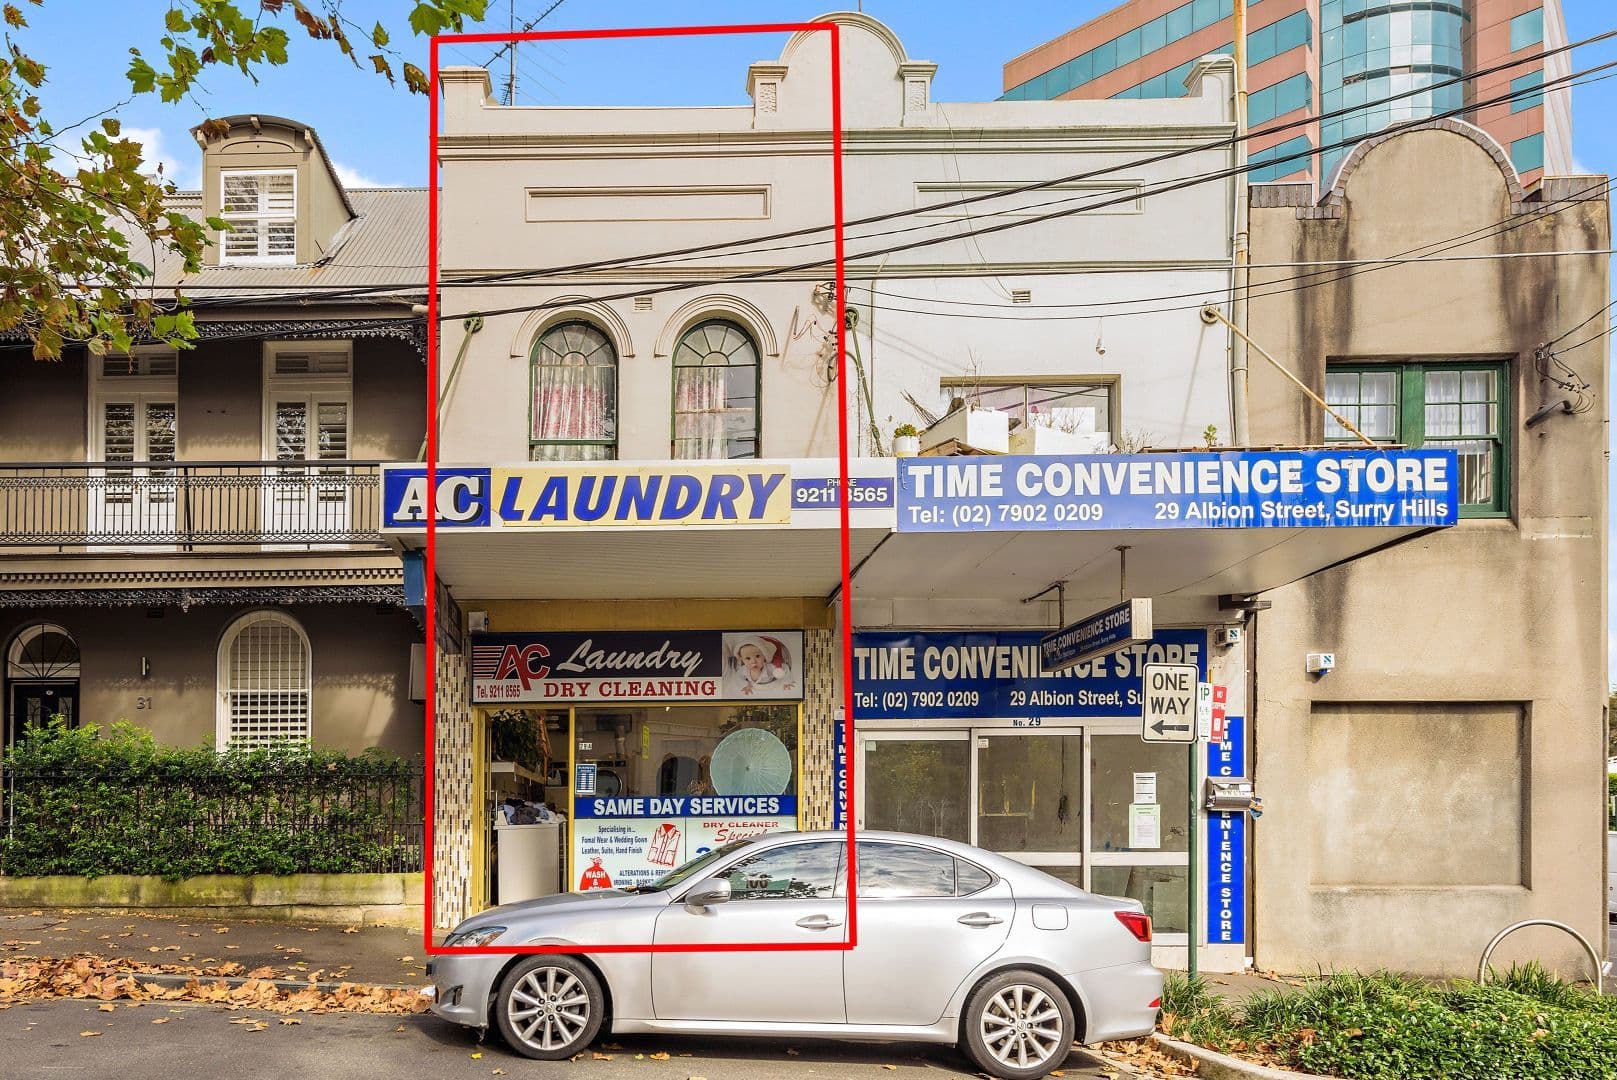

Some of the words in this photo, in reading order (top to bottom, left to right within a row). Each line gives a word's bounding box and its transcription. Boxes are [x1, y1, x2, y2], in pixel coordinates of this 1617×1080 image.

[827, 479, 857, 487] PHNE
[907, 464, 1004, 498] TIME
[1016, 459, 1303, 497] CONVENIENCE
[1316, 457, 1448, 493] STORE
[393, 475, 484, 521] AC
[500, 473, 786, 521] LAUNDRY
[796, 488, 836, 503] 9211
[908, 506, 945, 523] Tel:
[952, 505, 992, 527] (02)
[999, 504, 1047, 522] 7902
[1053, 503, 1104, 521] 0209
[1154, 502, 1179, 520] 29
[1185, 502, 1254, 519] Albion
[1260, 501, 1331, 521] Street,
[1335, 501, 1395, 523] Surry
[1401, 499, 1448, 517] Hills
[1105, 608, 1130, 630] STORE
[495, 644, 550, 690] AC
[556, 638, 703, 678] Laundry
[854, 647, 916, 680] TIME
[490, 684, 504, 698] 9211
[505, 684, 521, 698] 8565
[543, 682, 591, 698] DRY
[599, 681, 717, 697] CLEANING
[1152, 672, 1189, 691] ONE
[136, 696, 153, 710] 31
[855, 692, 878, 708] Tel:
[882, 691, 908, 711] (02)
[912, 691, 944, 707] 7902
[947, 691, 979, 707] 0209
[1010, 691, 1026, 706] 29
[1029, 690, 1073, 706] Albion
[1078, 690, 1123, 707] Street,
[1150, 697, 1190, 715] WAY
[1028, 717, 1041, 726] 29
[593, 799, 644, 816] SAME
[649, 799, 685, 815] DAY
[690, 797, 780, 815] SERVICES
[838, 769, 848, 831] CONVEN
[1220, 888, 1233, 942] STORE
